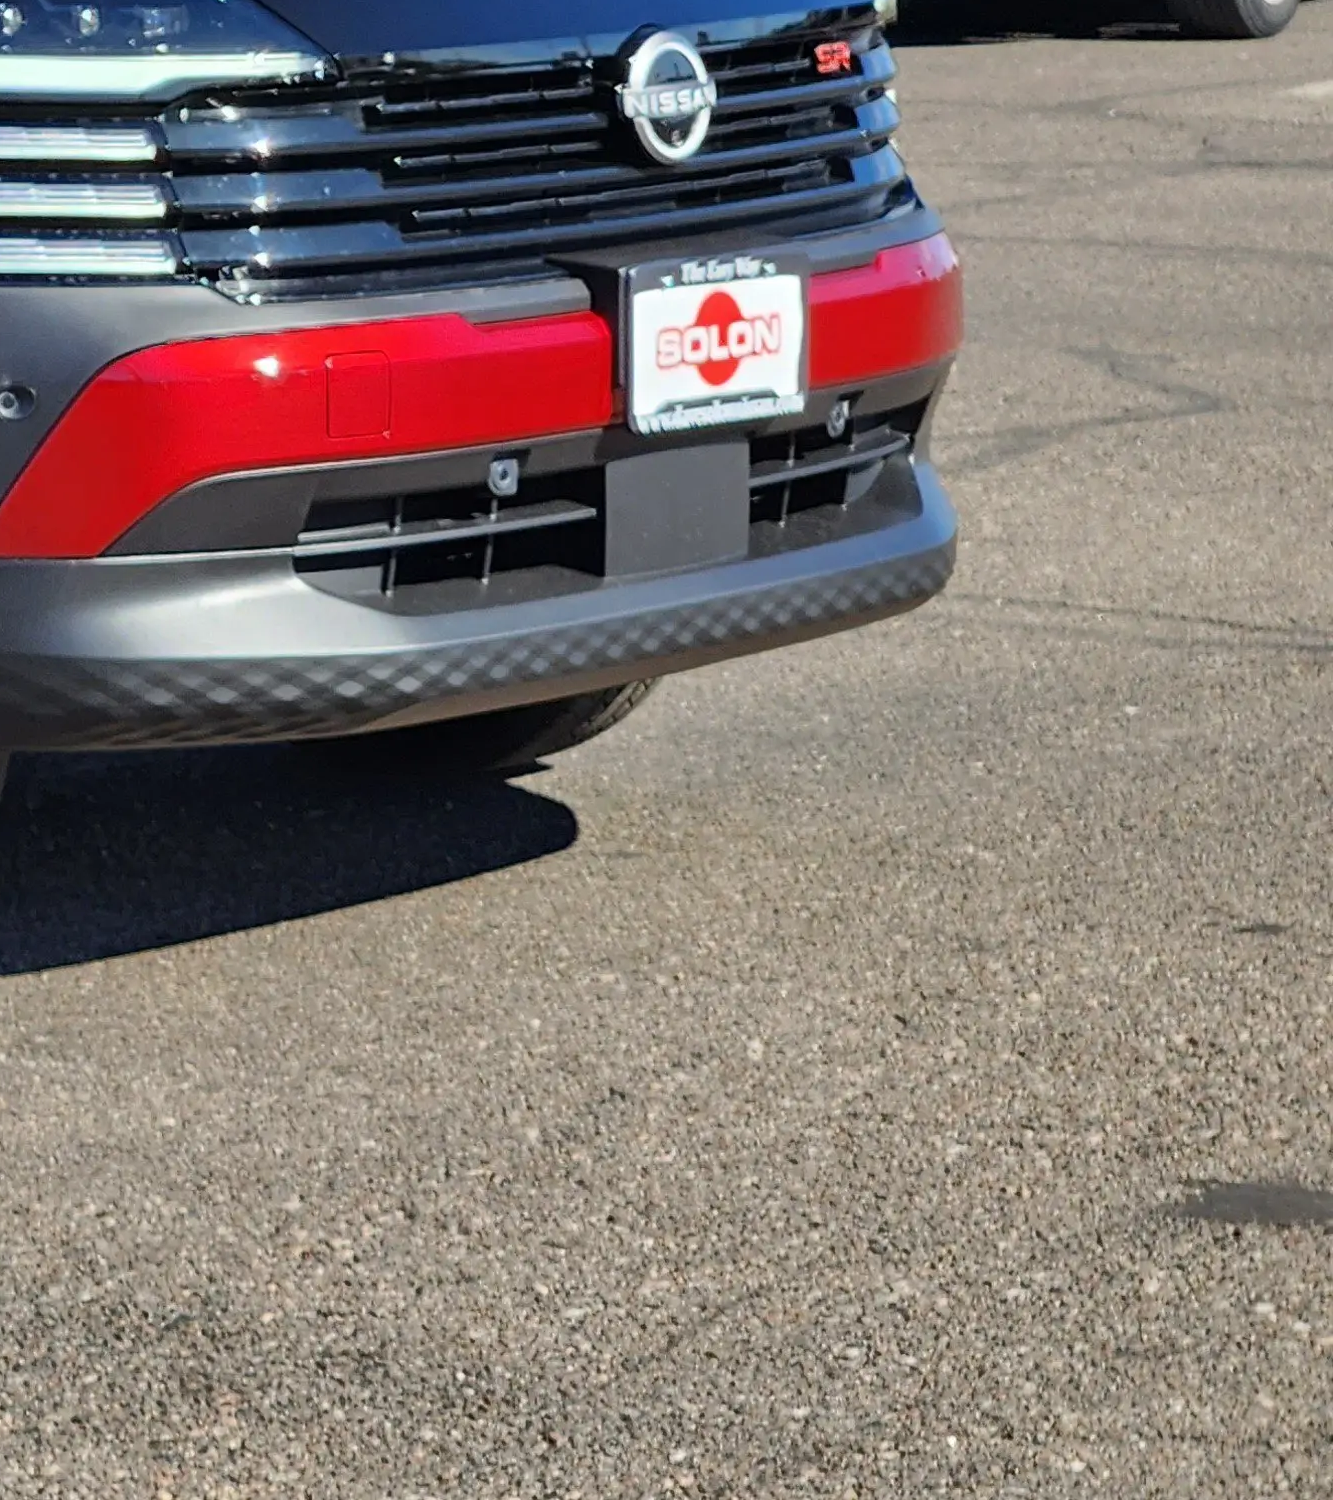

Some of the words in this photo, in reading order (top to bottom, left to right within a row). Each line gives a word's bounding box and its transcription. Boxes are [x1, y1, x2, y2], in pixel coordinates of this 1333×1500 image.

[814, 41, 851, 74] SR
[629, 84, 716, 116] NISSAN
[656, 313, 782, 369] SOLON
